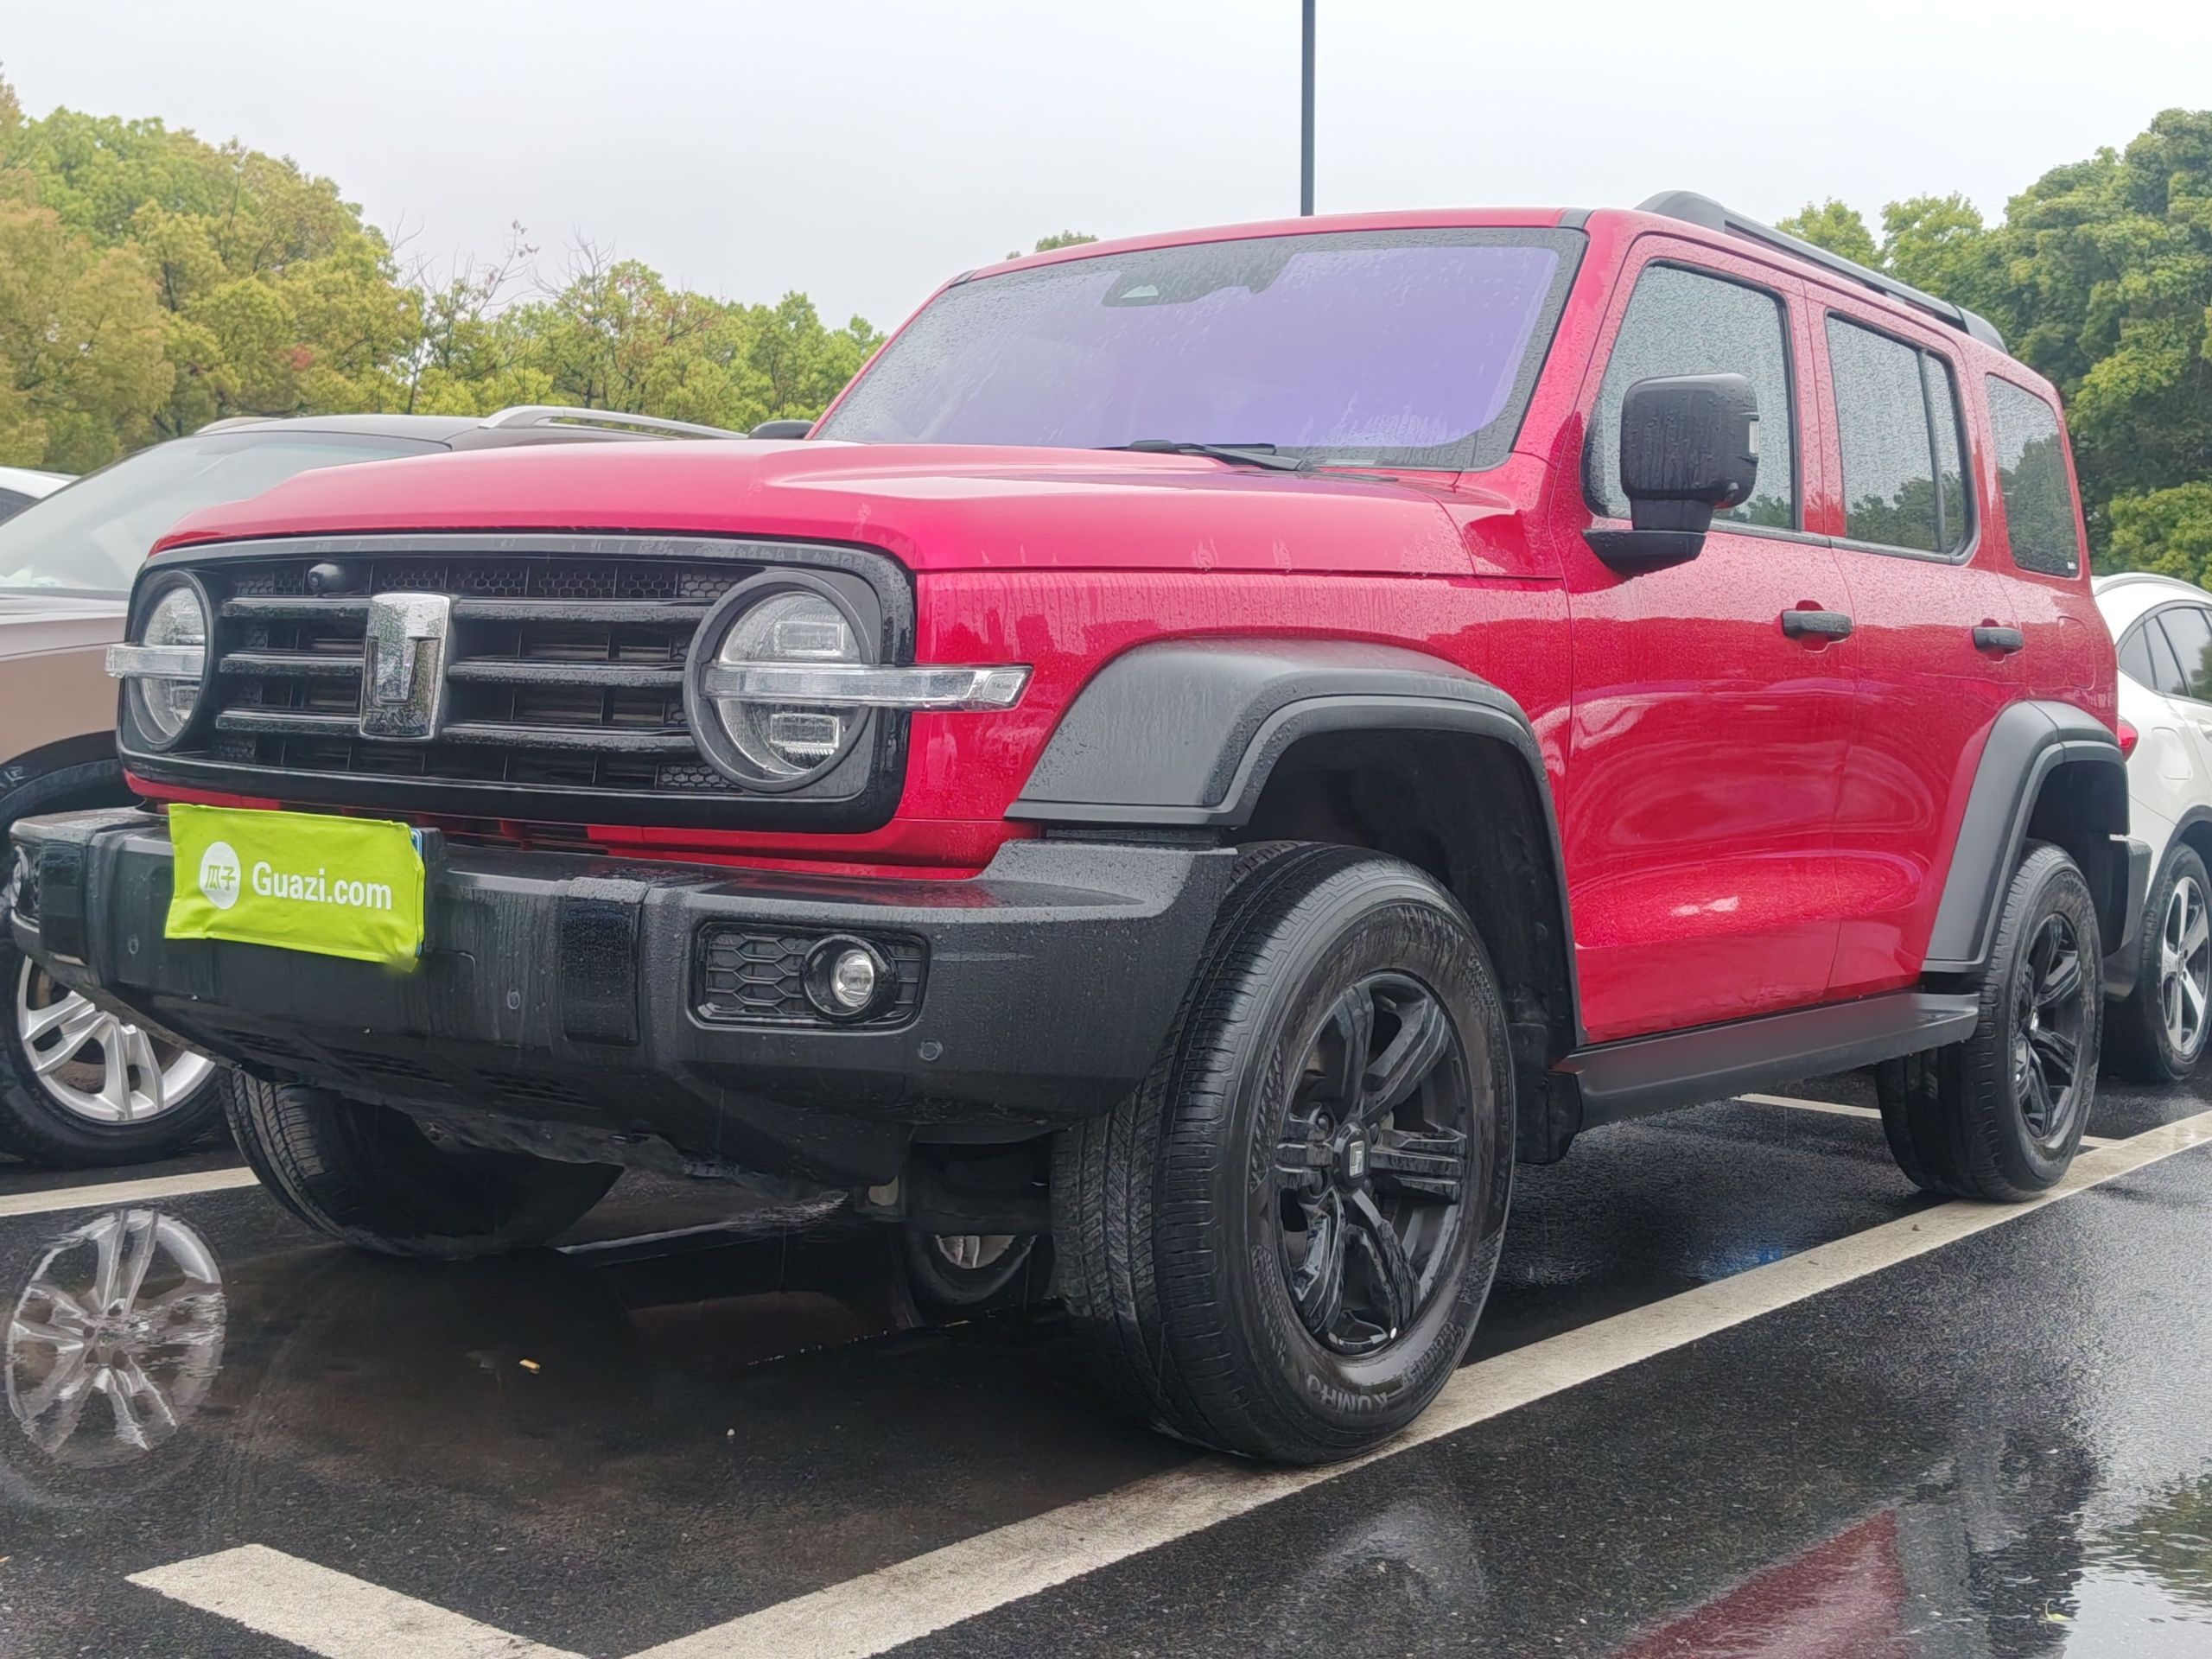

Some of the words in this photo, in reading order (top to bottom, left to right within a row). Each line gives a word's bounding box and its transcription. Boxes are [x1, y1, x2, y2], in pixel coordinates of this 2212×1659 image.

[365, 709, 418, 726] TANK
[205, 865, 237, 892] 瓜子
[251, 861, 392, 910] Guazi.com
